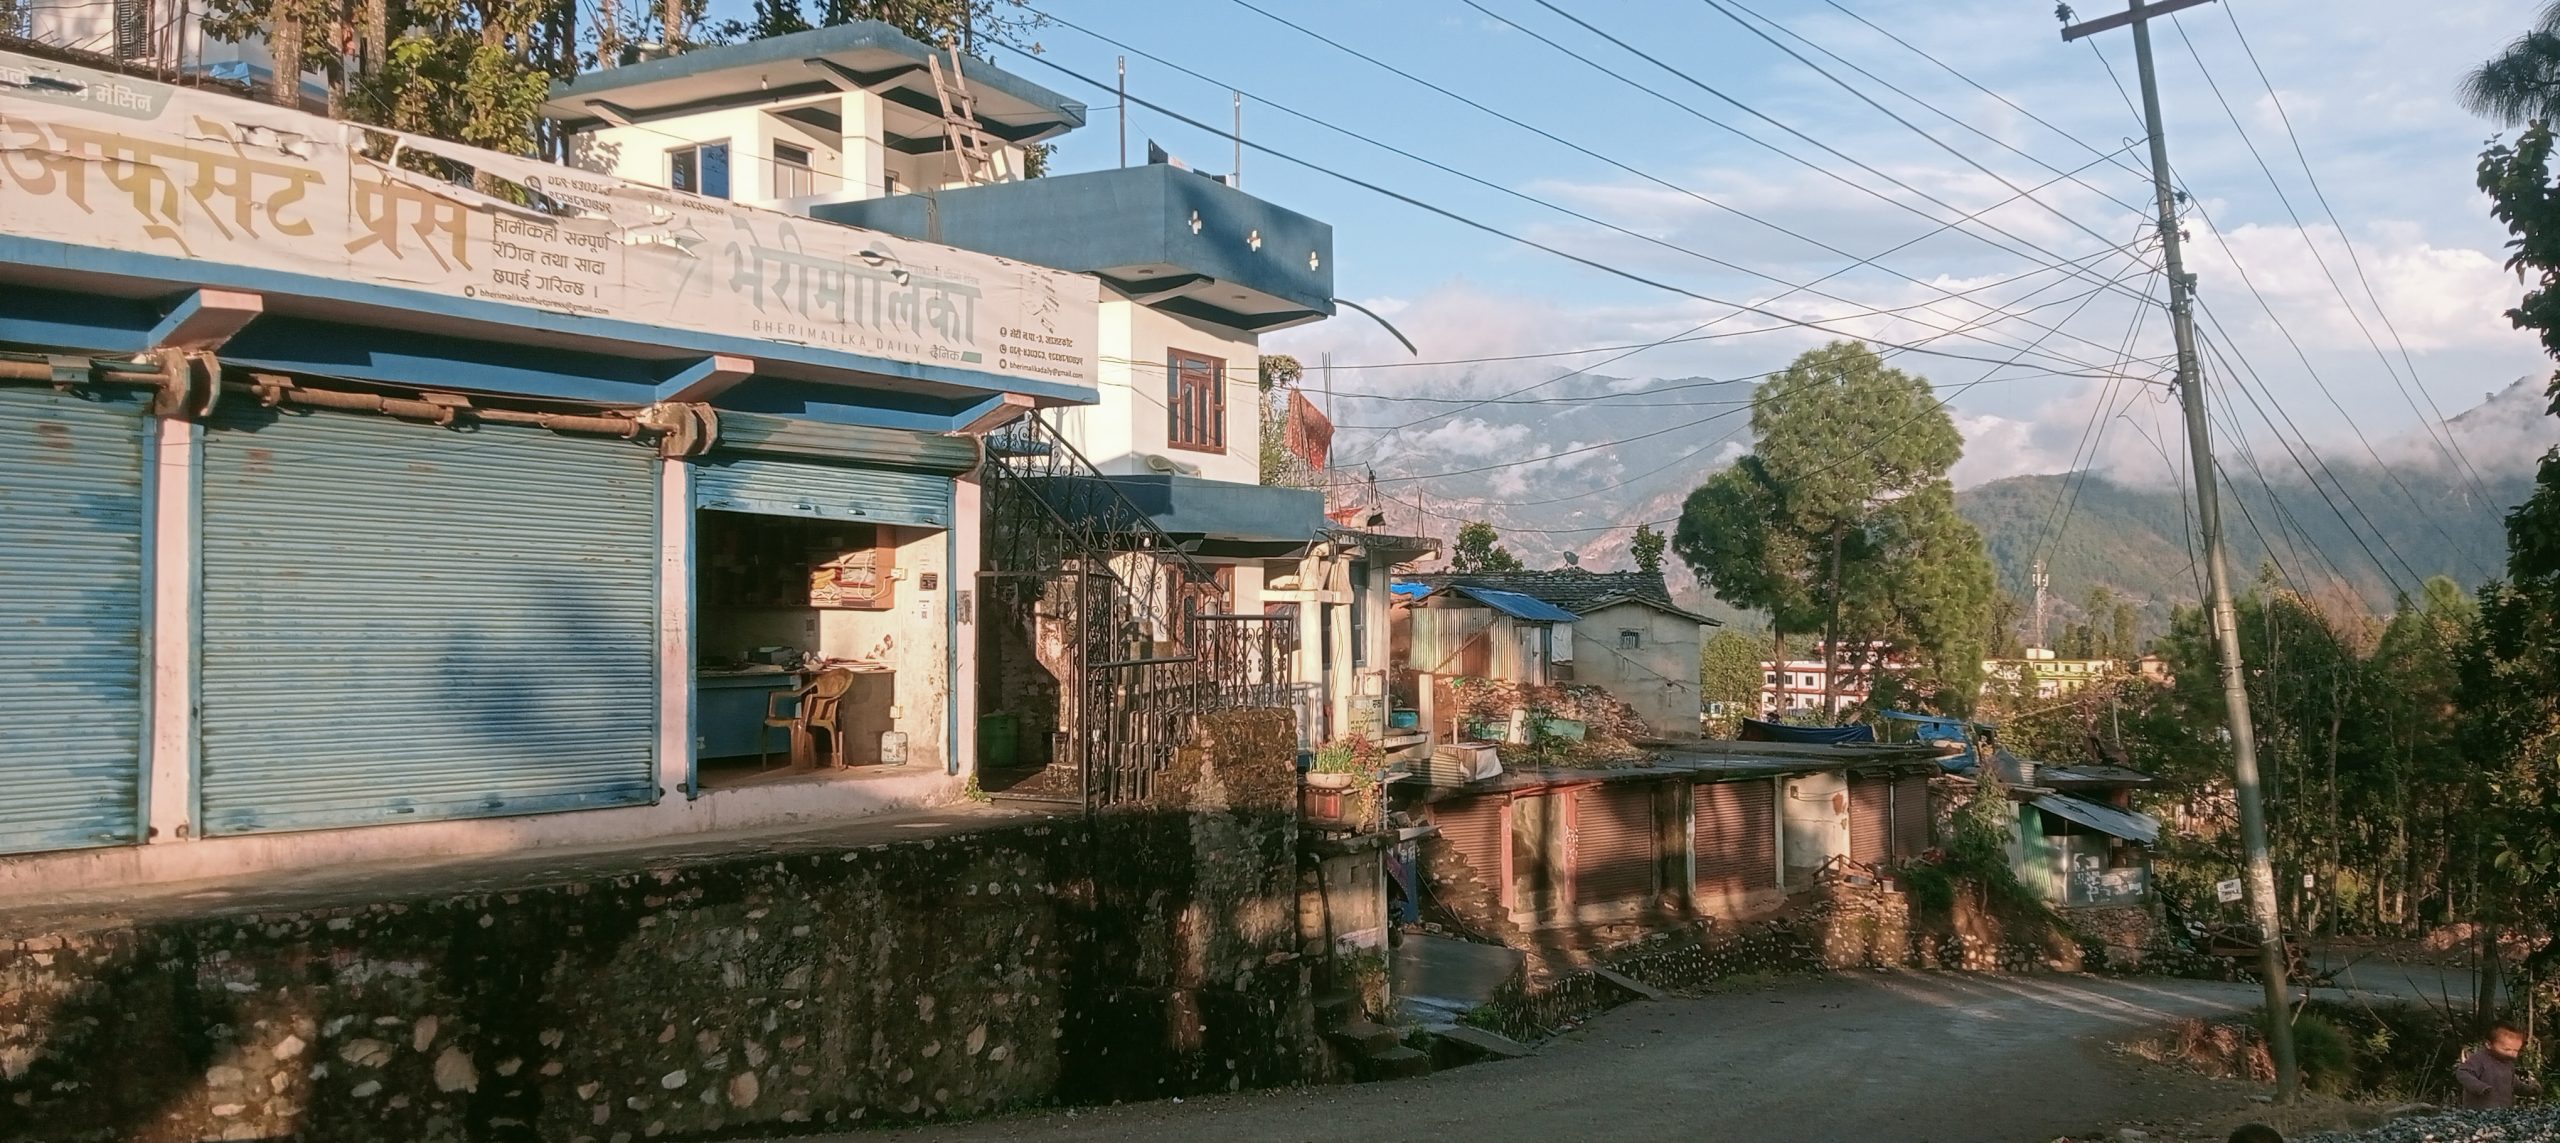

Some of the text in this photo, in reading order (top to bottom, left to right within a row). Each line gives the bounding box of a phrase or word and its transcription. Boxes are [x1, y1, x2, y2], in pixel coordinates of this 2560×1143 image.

[540, 251, 569, 269] तथा
[574, 257, 605, 275] सादा
[493, 268, 531, 289] छपाई
[535, 275, 585, 296] गरिन्छ
[725, 214, 983, 346] भेरीमालिका
[877, 338, 921, 356] DAILY
[928, 343, 960, 361] दैनिक
